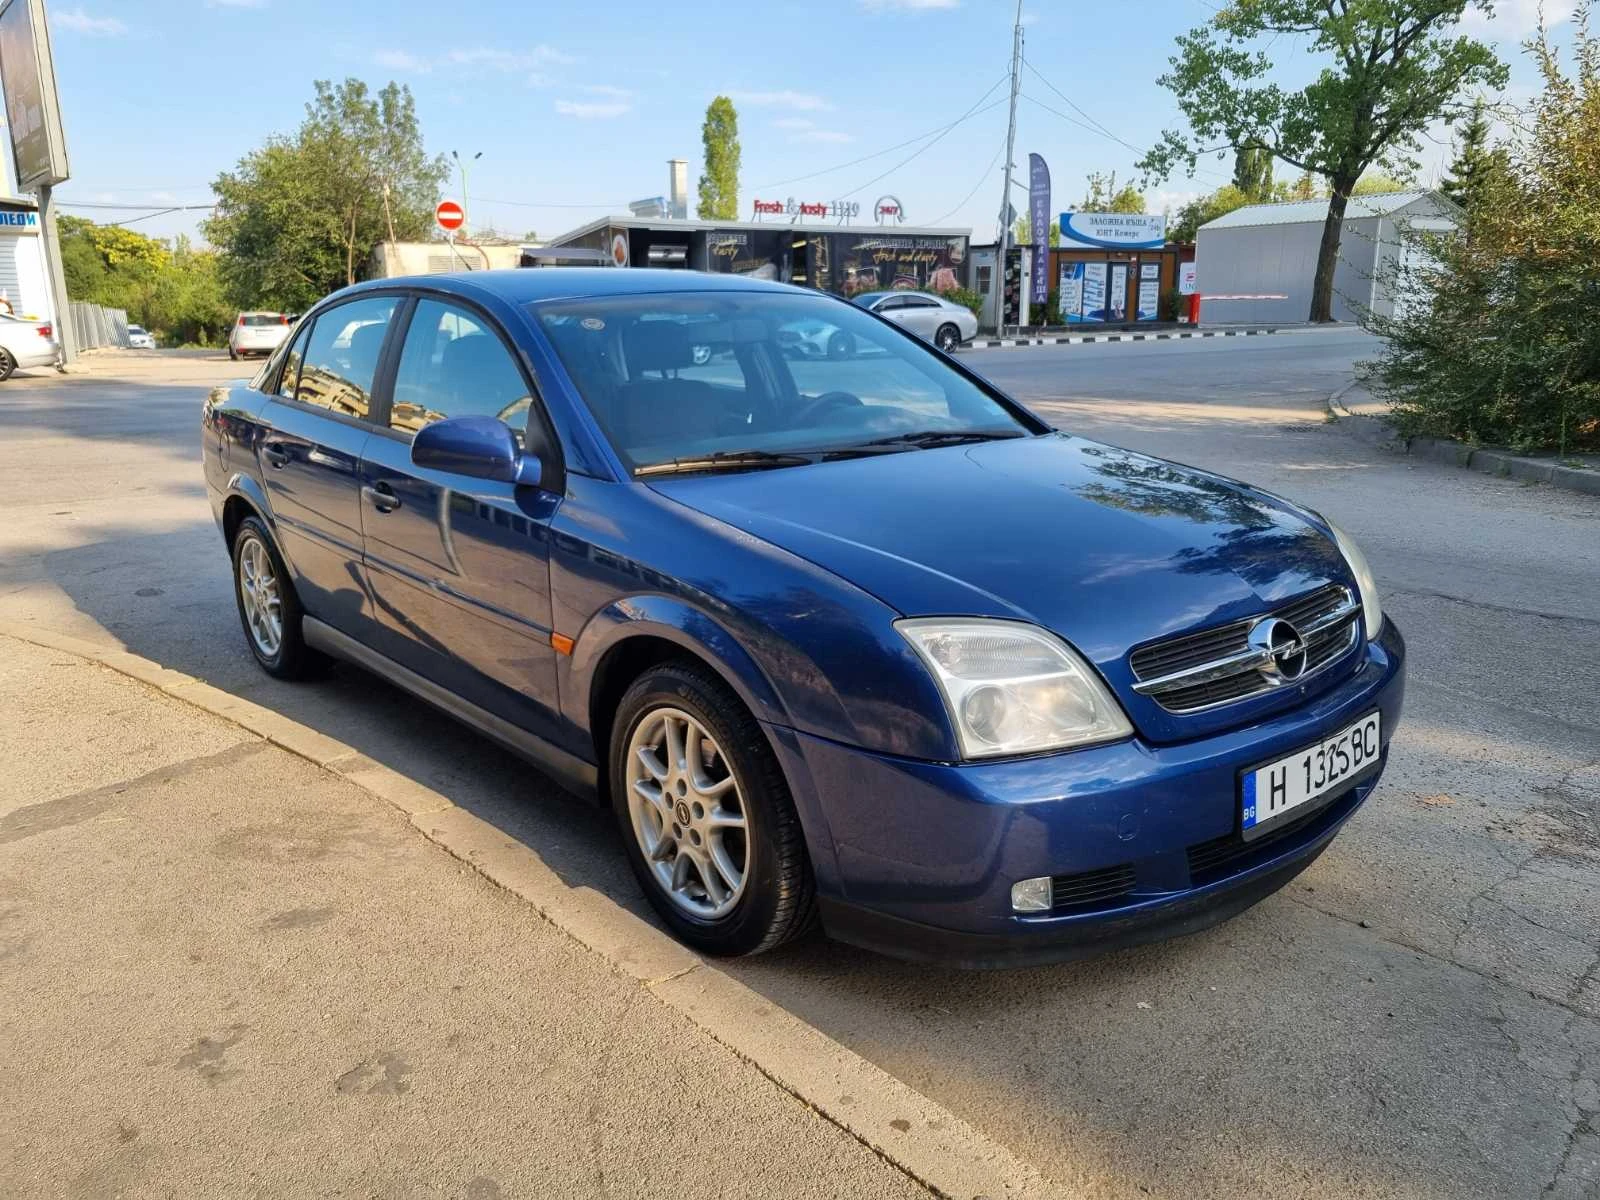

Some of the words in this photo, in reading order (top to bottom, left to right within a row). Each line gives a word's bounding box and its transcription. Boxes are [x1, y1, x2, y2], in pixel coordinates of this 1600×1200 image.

[754, 199, 783, 213] Fresh
[1270, 766, 1286, 810] H
[1243, 806, 1255, 821] BG
